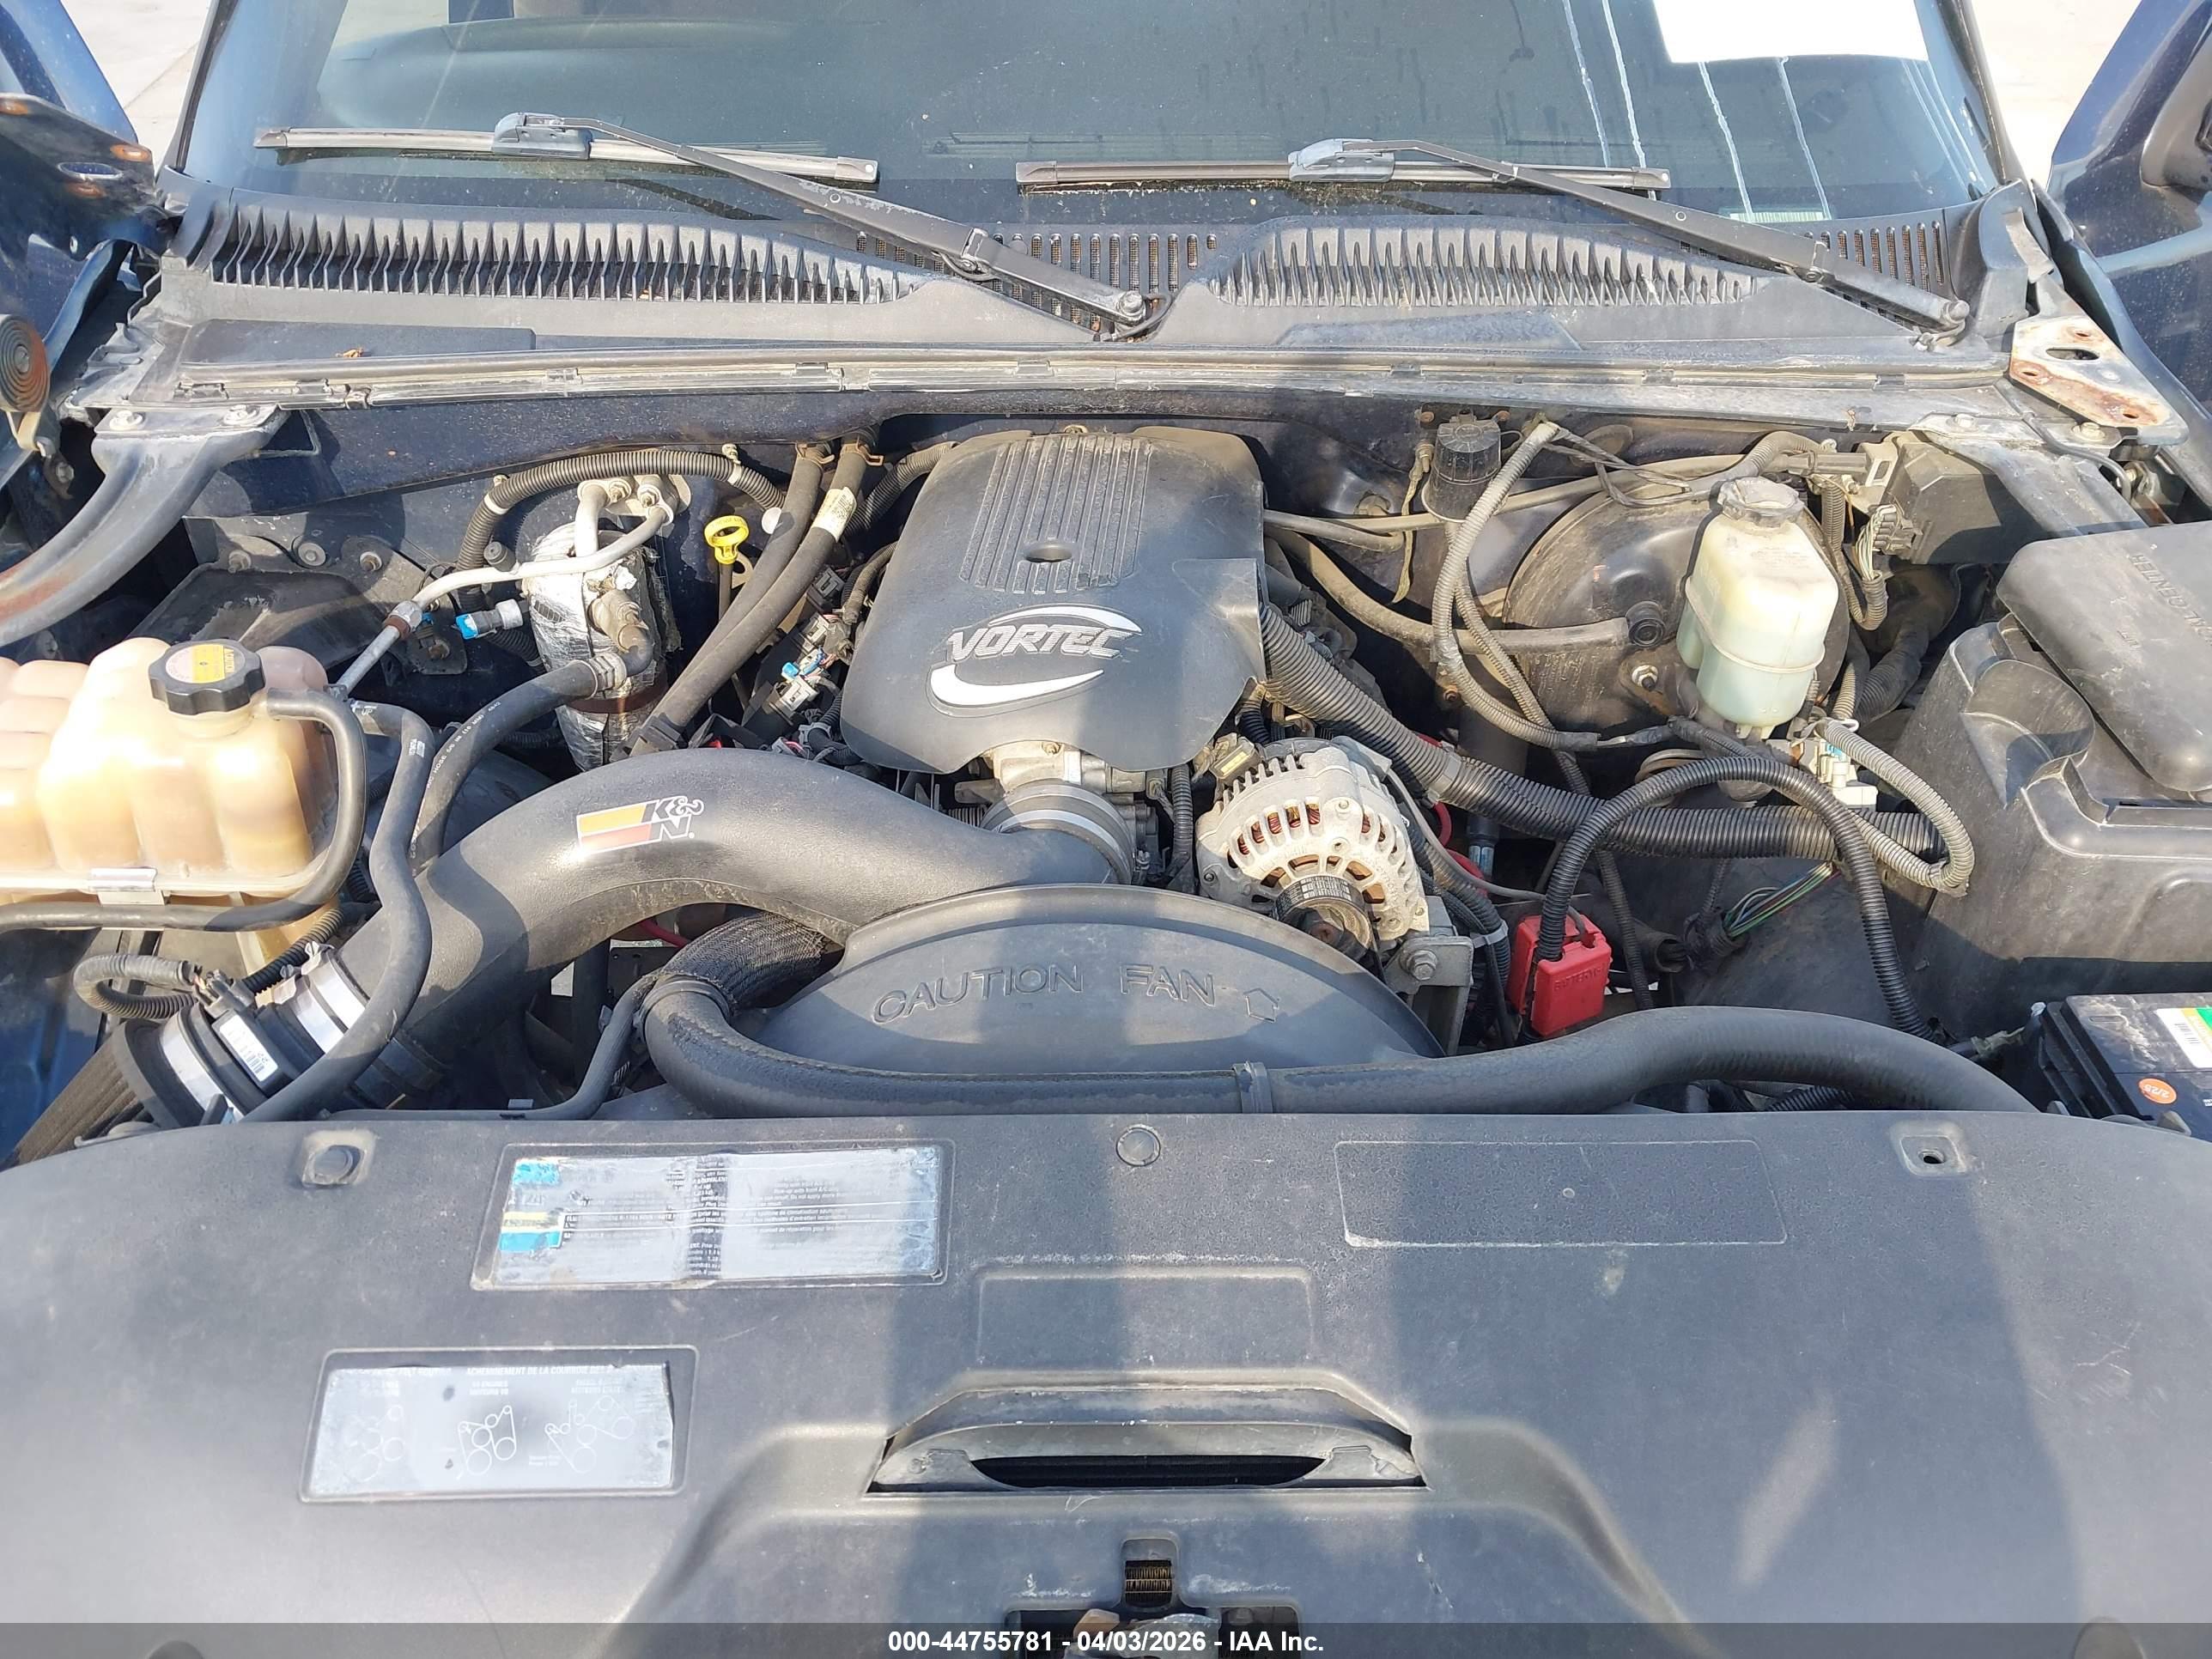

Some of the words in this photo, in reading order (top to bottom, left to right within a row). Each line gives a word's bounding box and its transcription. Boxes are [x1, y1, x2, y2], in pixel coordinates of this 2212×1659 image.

[947, 623, 1133, 662] VORTEC
[433, 755, 447, 774] HOSE
[872, 963, 1084, 1025] CAUTION
[1119, 963, 1216, 1008] FAN
